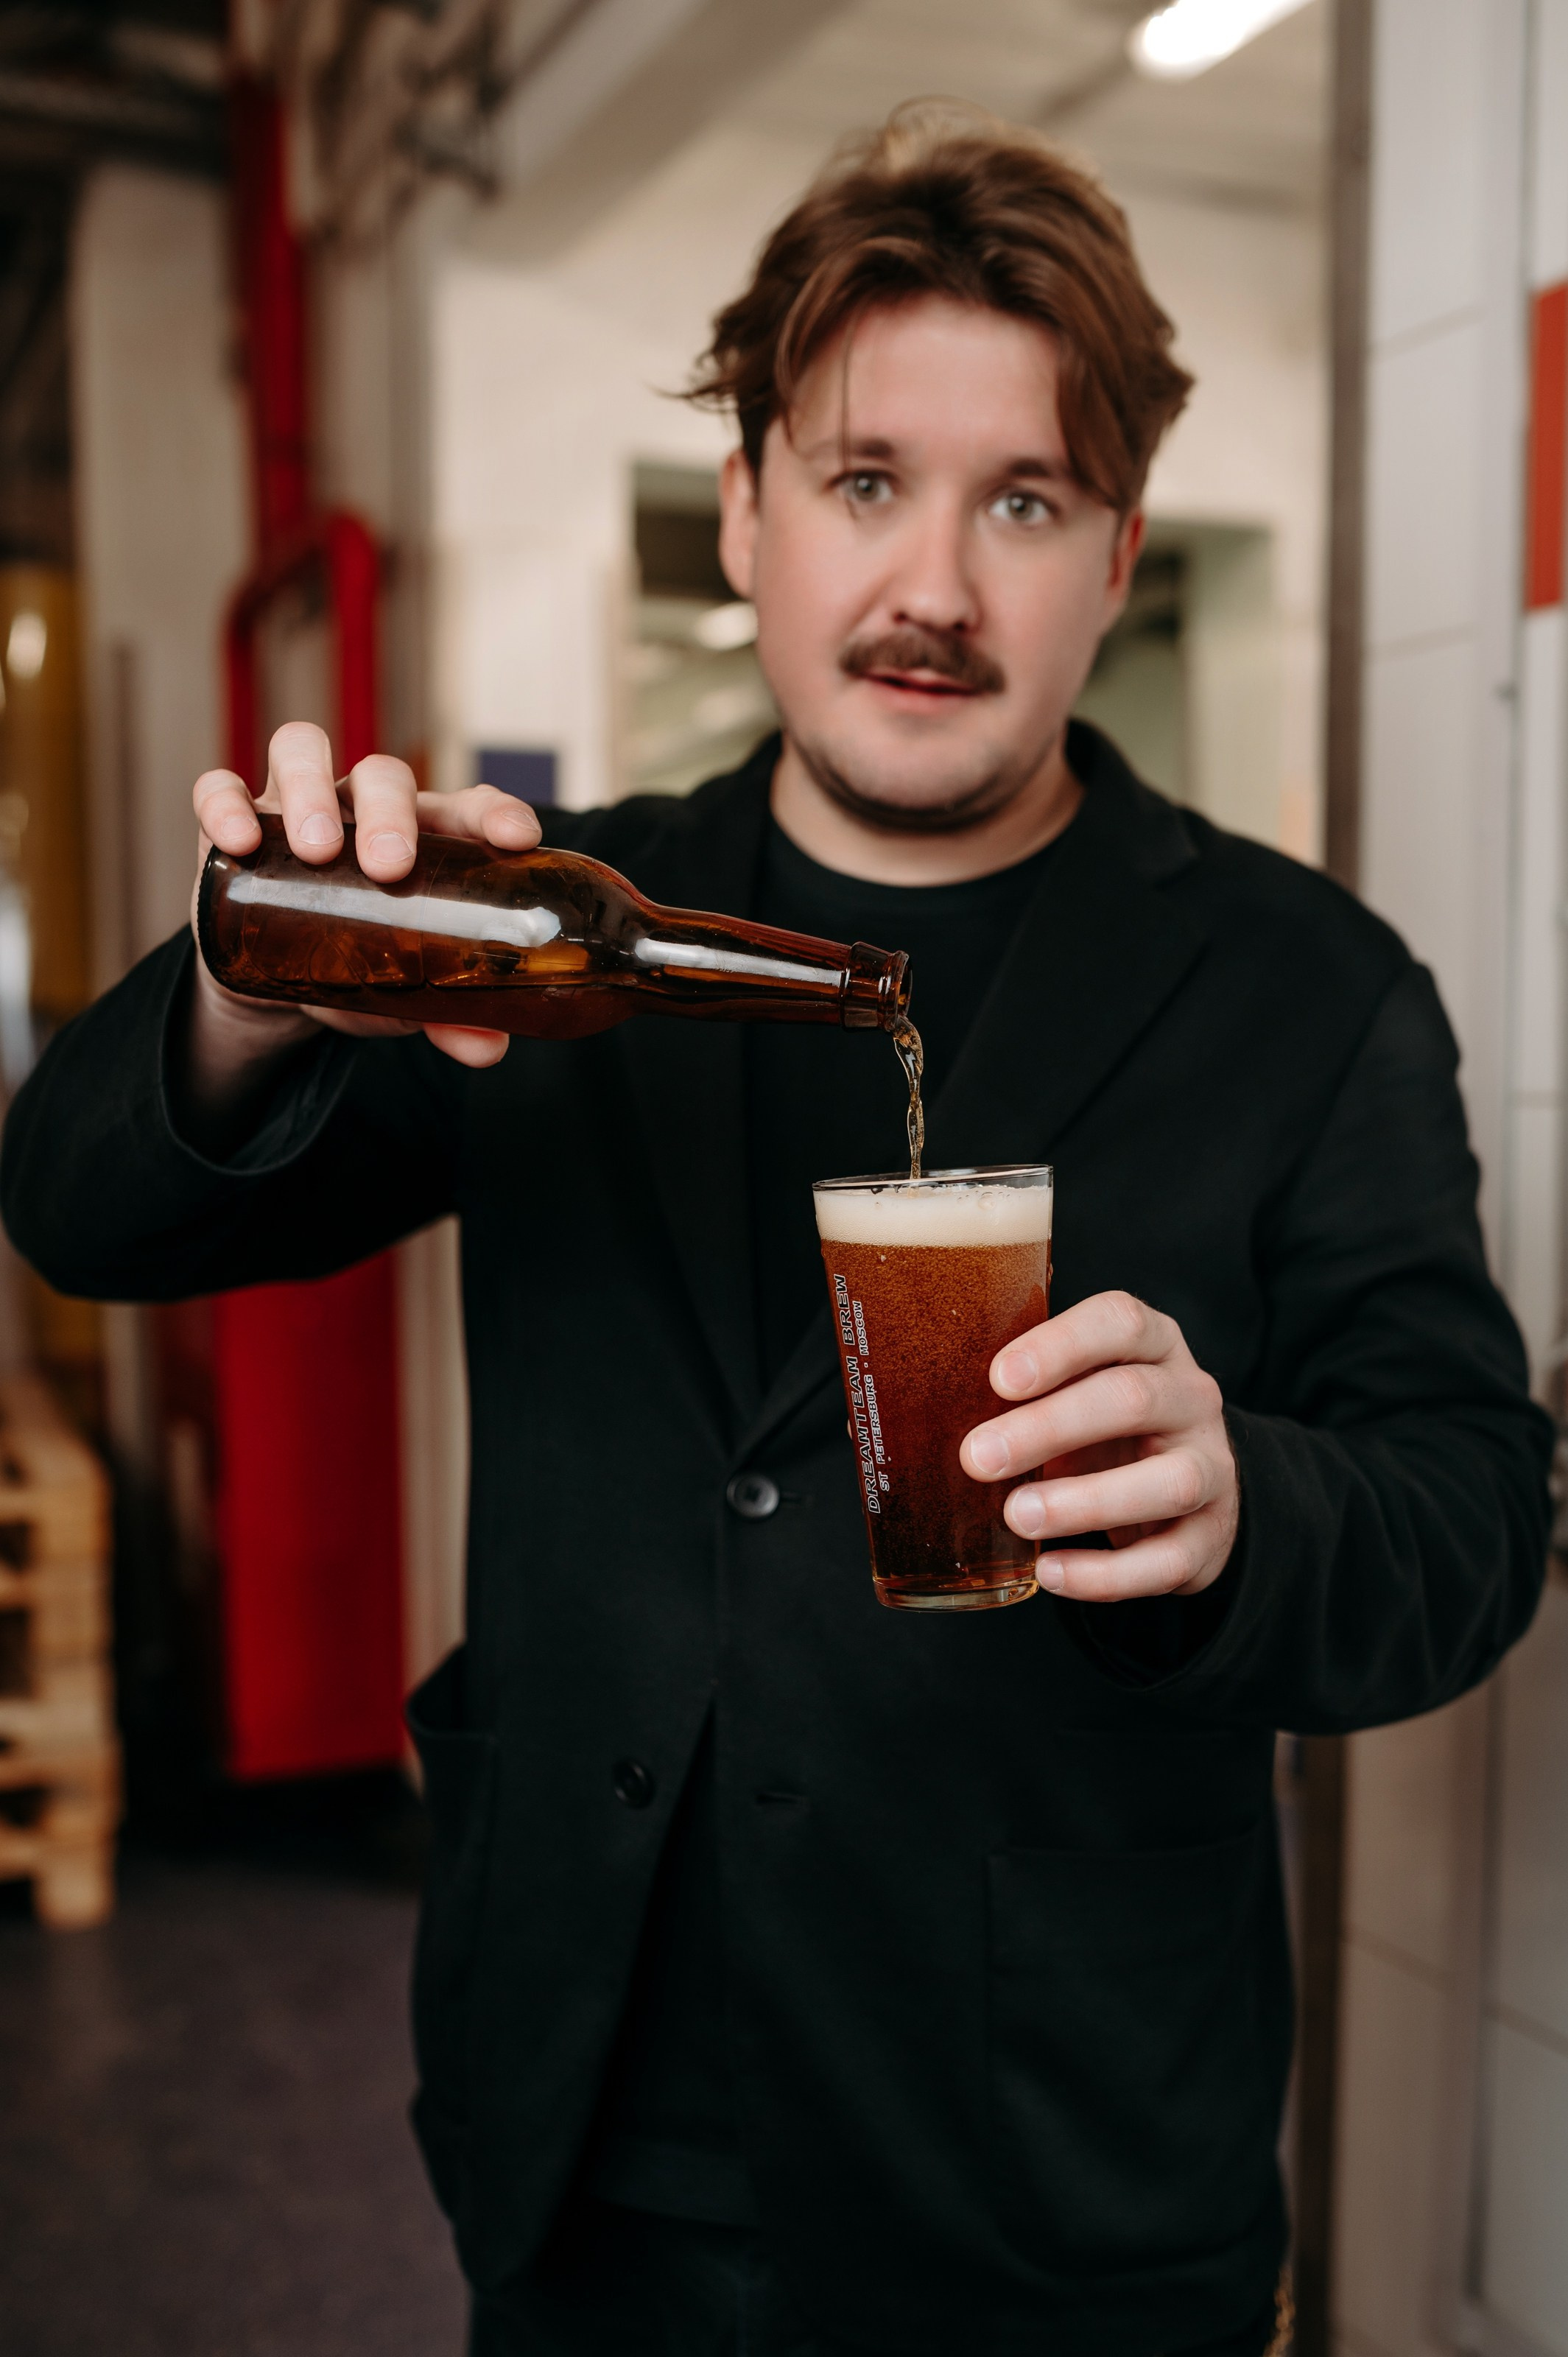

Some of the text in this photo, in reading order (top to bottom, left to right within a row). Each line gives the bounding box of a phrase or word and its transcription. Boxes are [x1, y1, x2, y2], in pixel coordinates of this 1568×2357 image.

[834, 1274, 880, 1514] DREAMTEAM BREW
[853, 1301, 890, 1492] ST PETERSBURG MOSCOW
